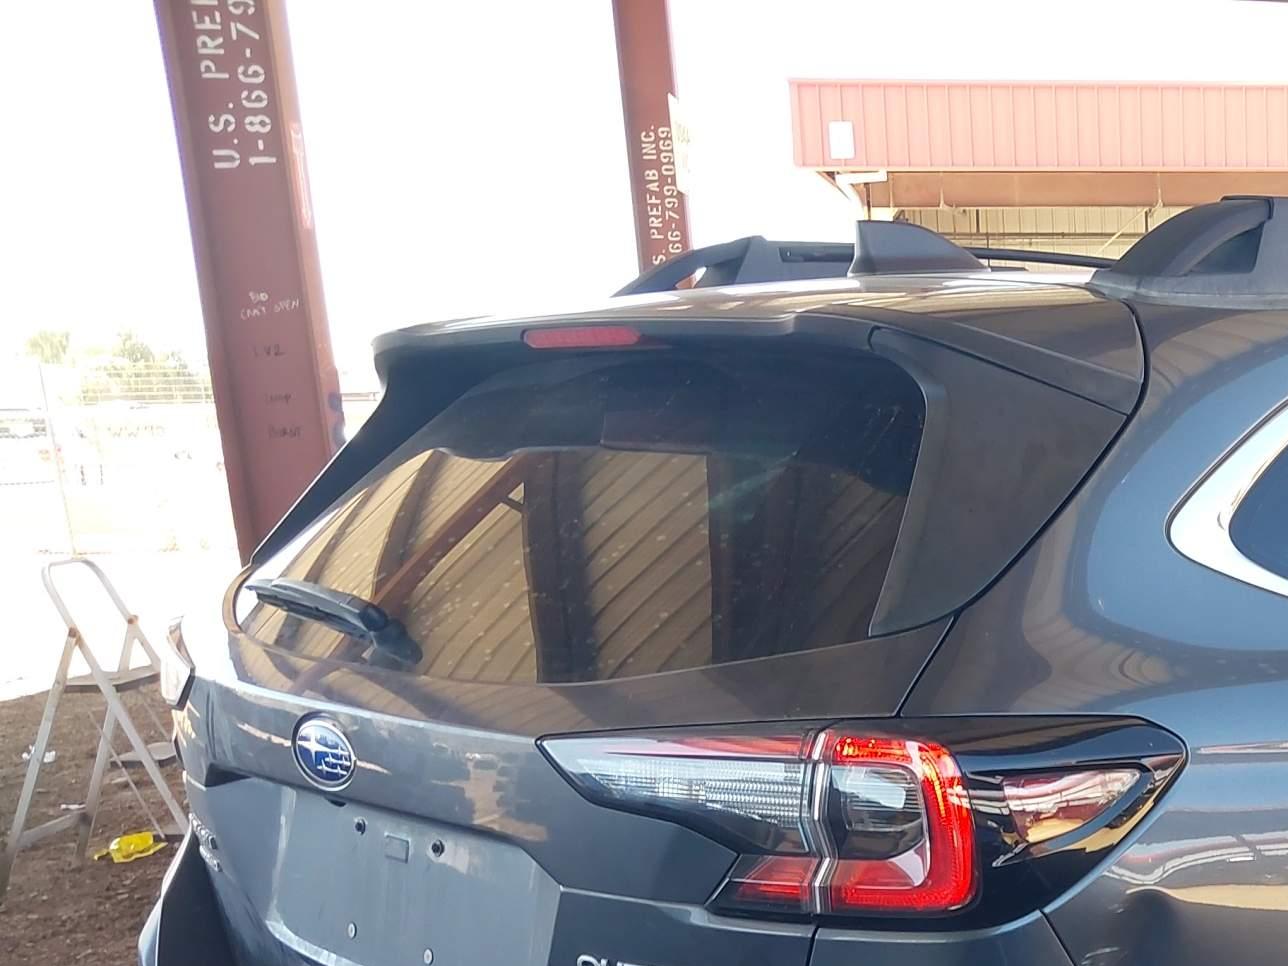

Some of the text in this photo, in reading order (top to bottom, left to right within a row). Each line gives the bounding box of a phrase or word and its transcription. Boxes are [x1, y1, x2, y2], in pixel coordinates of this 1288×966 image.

[190, 0, 241, 169] U.S. PRE
[640, 124, 657, 160] INC.
[645, 168, 665, 240] PREFAB
